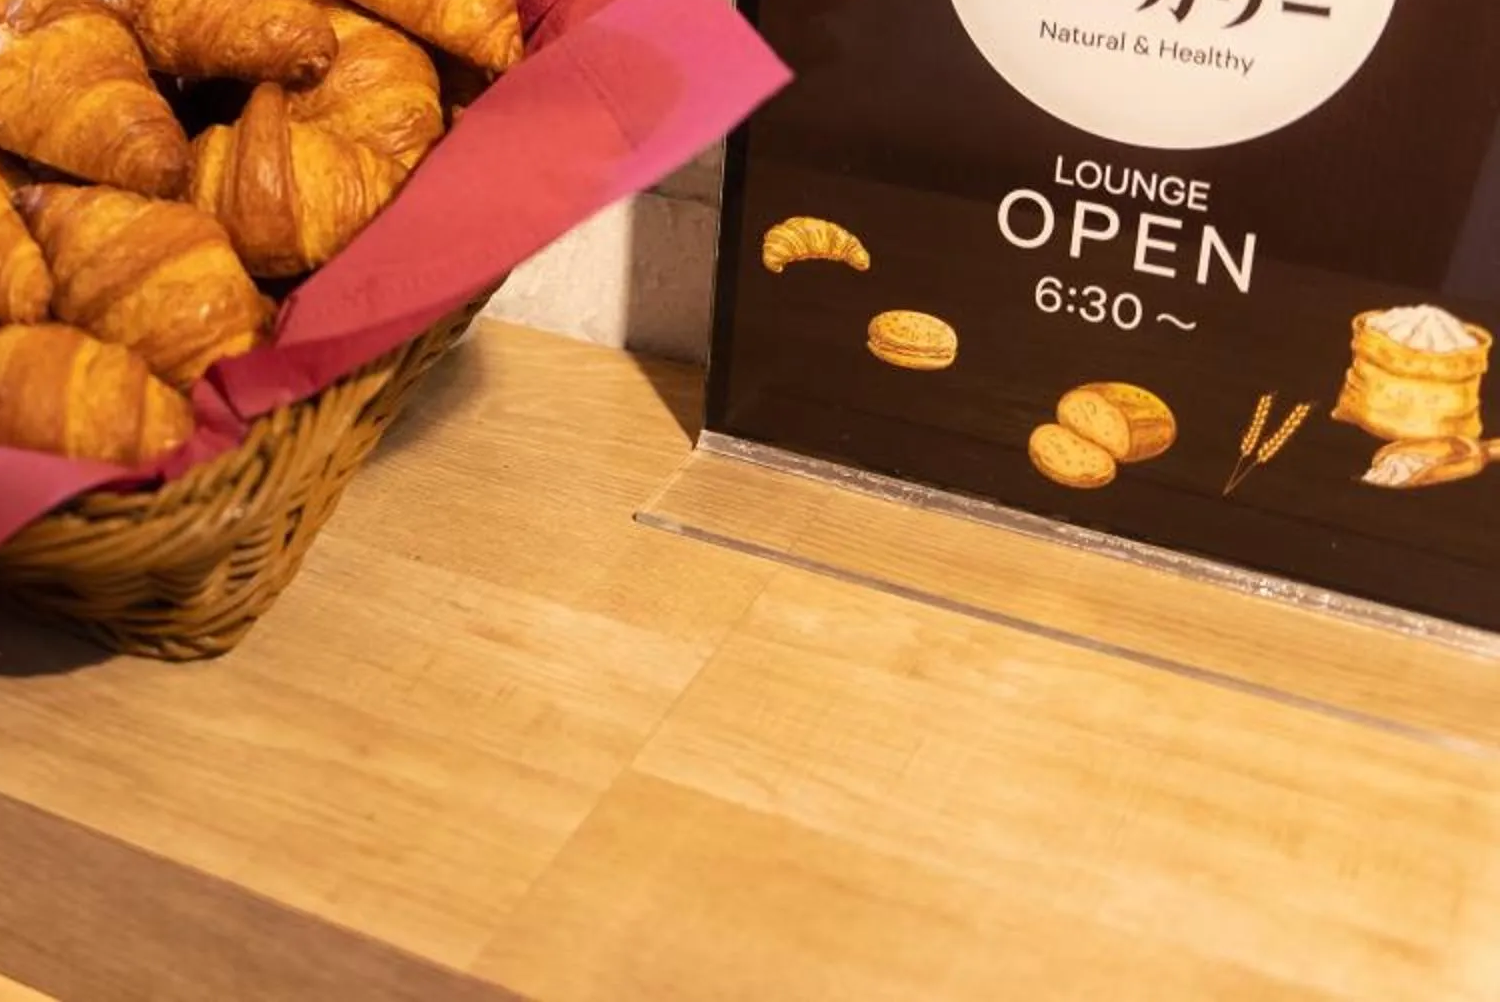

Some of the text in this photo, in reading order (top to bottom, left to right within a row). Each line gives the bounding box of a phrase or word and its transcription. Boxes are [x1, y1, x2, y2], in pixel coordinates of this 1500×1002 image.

[1038, 19, 1255, 76] Natural & Healthy
[1054, 154, 1212, 212] LOUNGE
[997, 188, 1257, 294] OPEN
